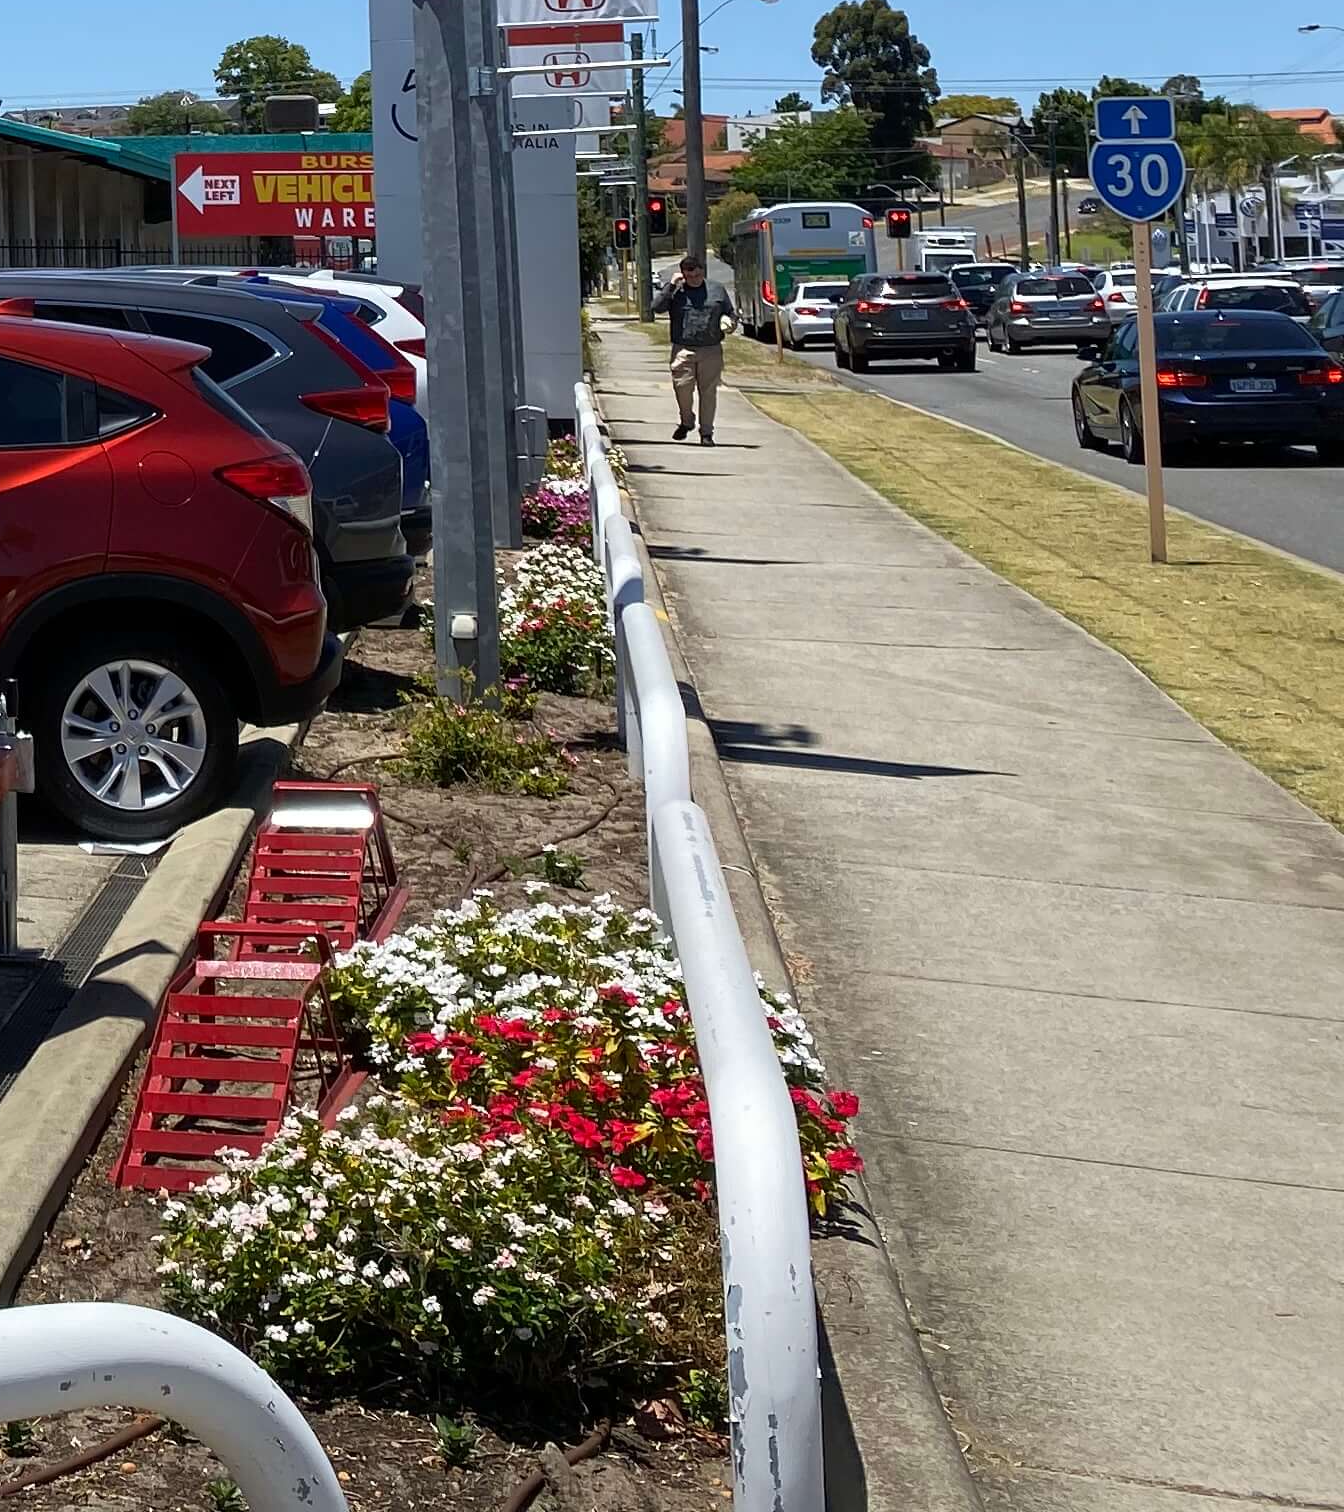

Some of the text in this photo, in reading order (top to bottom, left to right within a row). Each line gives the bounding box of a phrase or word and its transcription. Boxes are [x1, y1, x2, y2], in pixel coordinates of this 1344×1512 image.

[301, 155, 374, 169] BURS
[1107, 154, 1169, 197] 30
[204, 179, 236, 189] NEXT
[205, 191, 235, 201] LEFT
[294, 207, 376, 228] WARE
